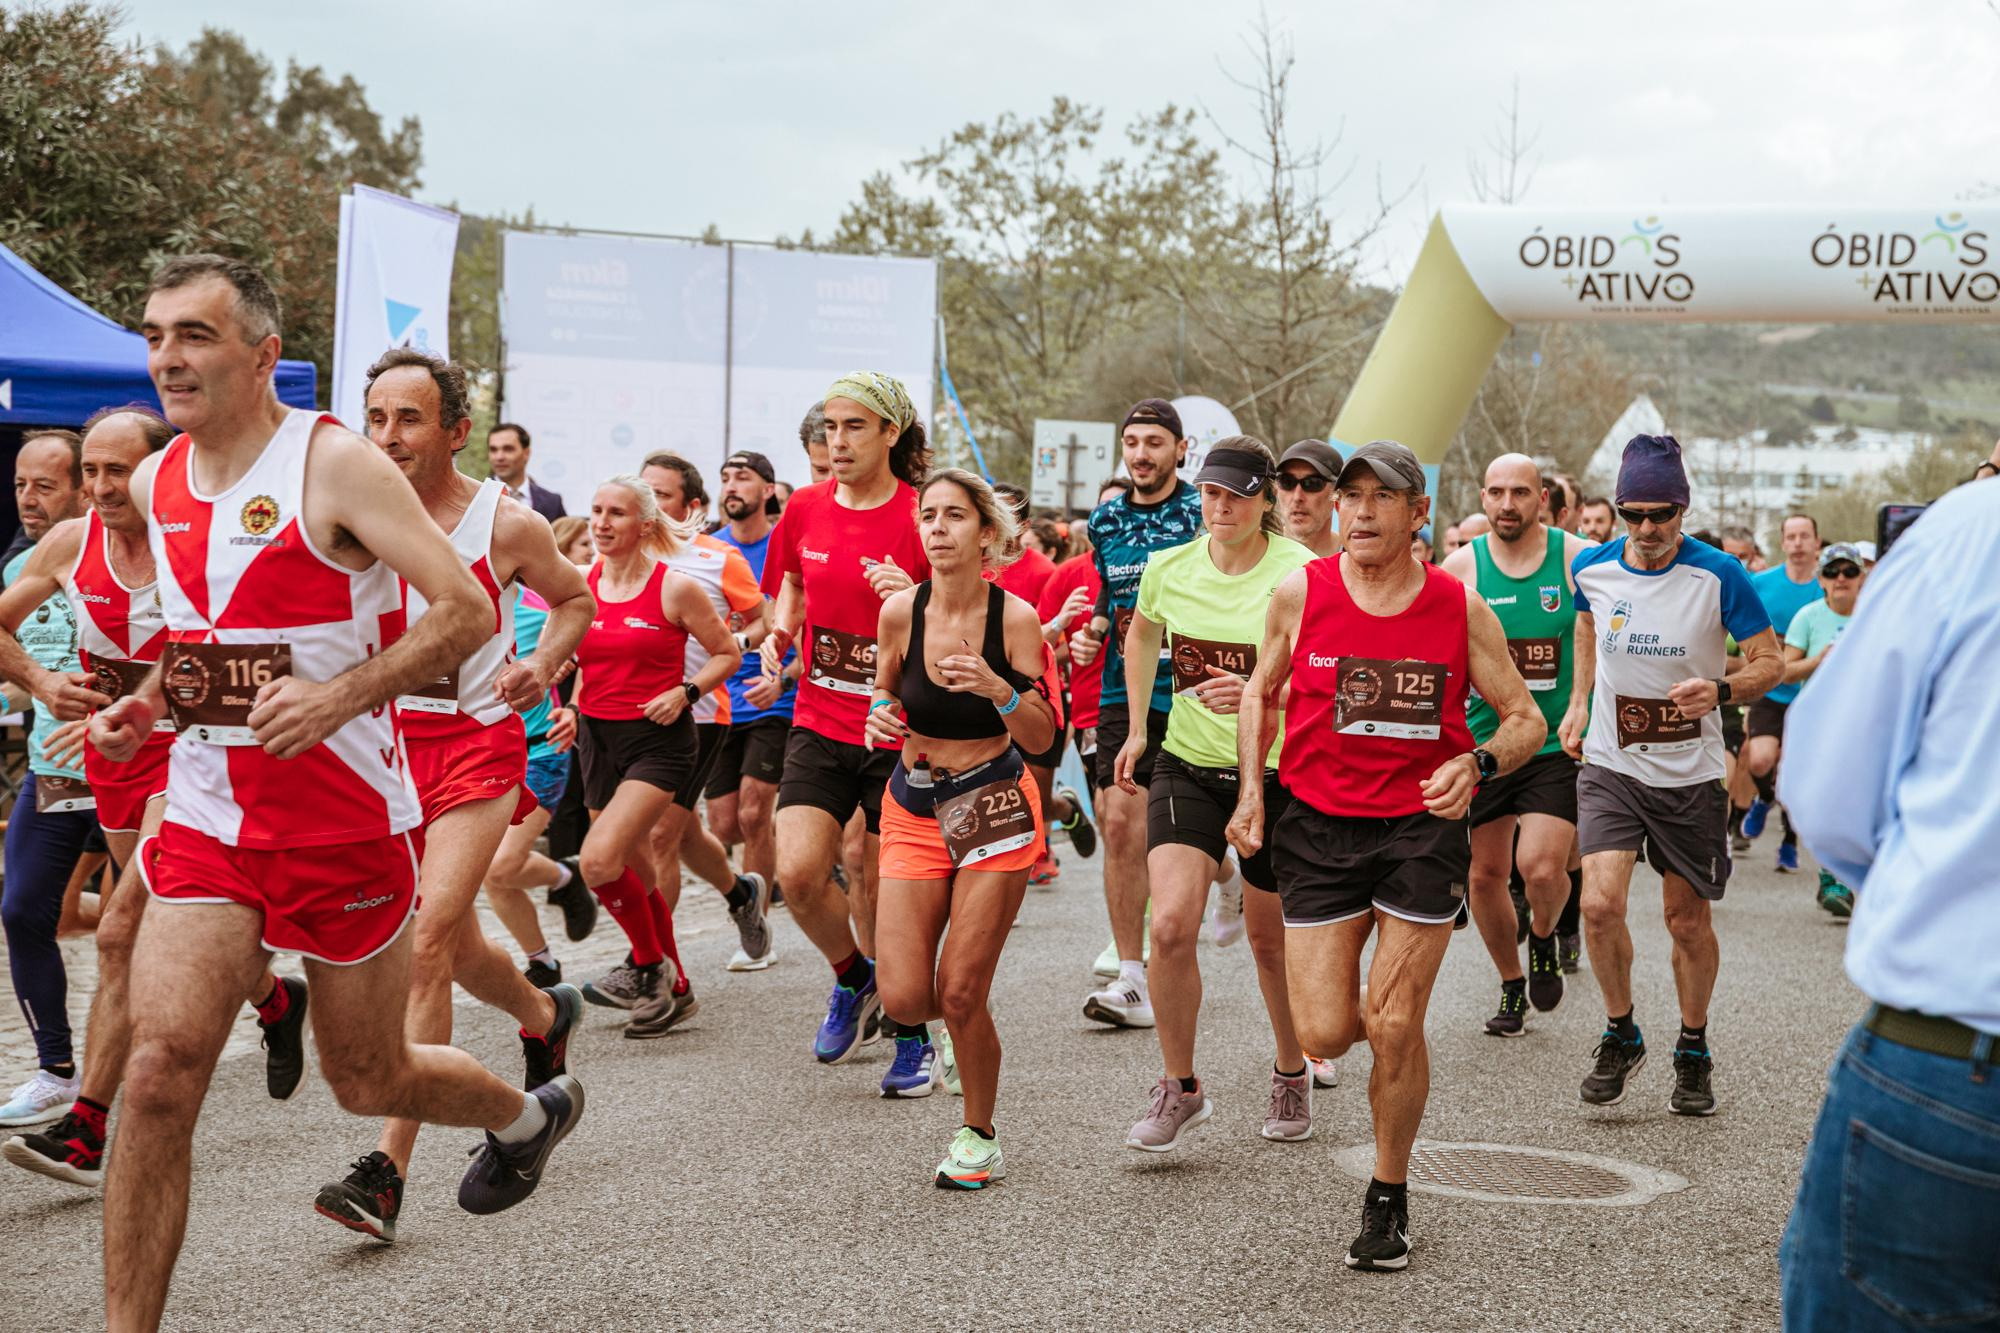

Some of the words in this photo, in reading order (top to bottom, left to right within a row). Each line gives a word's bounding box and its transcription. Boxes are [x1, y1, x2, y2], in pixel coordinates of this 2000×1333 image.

[1629, 633, 1660, 645] BEER
[851, 644, 875, 664] 46
[1526, 645, 1554, 661] 193
[1627, 645, 1686, 657] RUNNERS
[1215, 650, 1245, 670] 141
[225, 659, 272, 687] 116
[1395, 672, 1436, 696] 125
[1390, 700, 1412, 709] 10km
[1659, 706, 1688, 722] 12
[981, 788, 1021, 816] 229
[989, 818, 1009, 828] 10km
